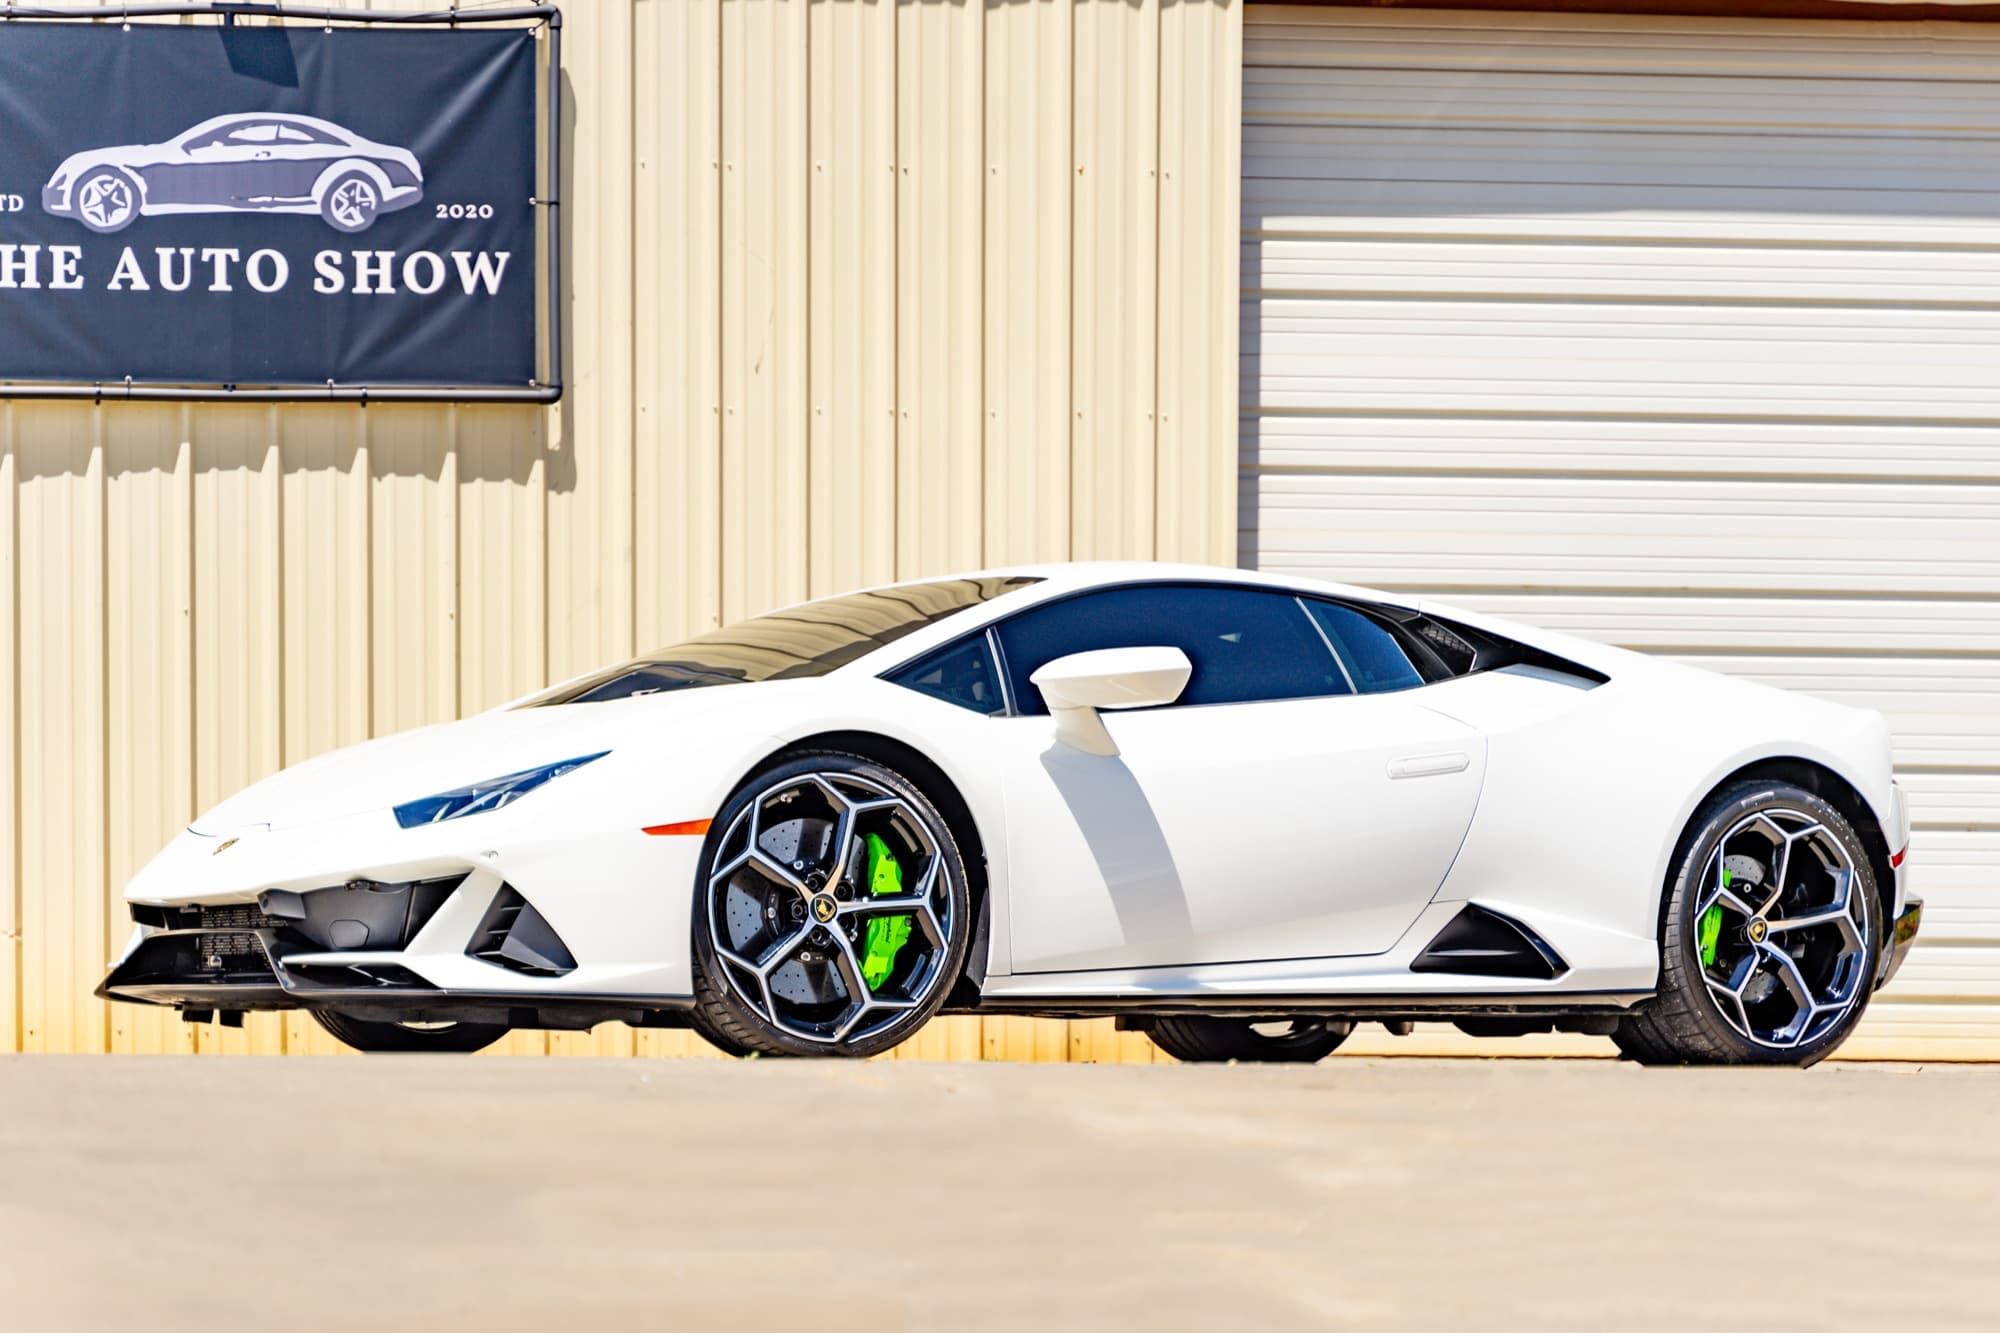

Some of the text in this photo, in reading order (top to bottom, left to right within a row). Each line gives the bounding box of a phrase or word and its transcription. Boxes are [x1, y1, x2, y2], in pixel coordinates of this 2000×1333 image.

[435, 204, 494, 219] 2020
[106, 246, 289, 292] AUTO
[313, 249, 511, 295] SHOW
